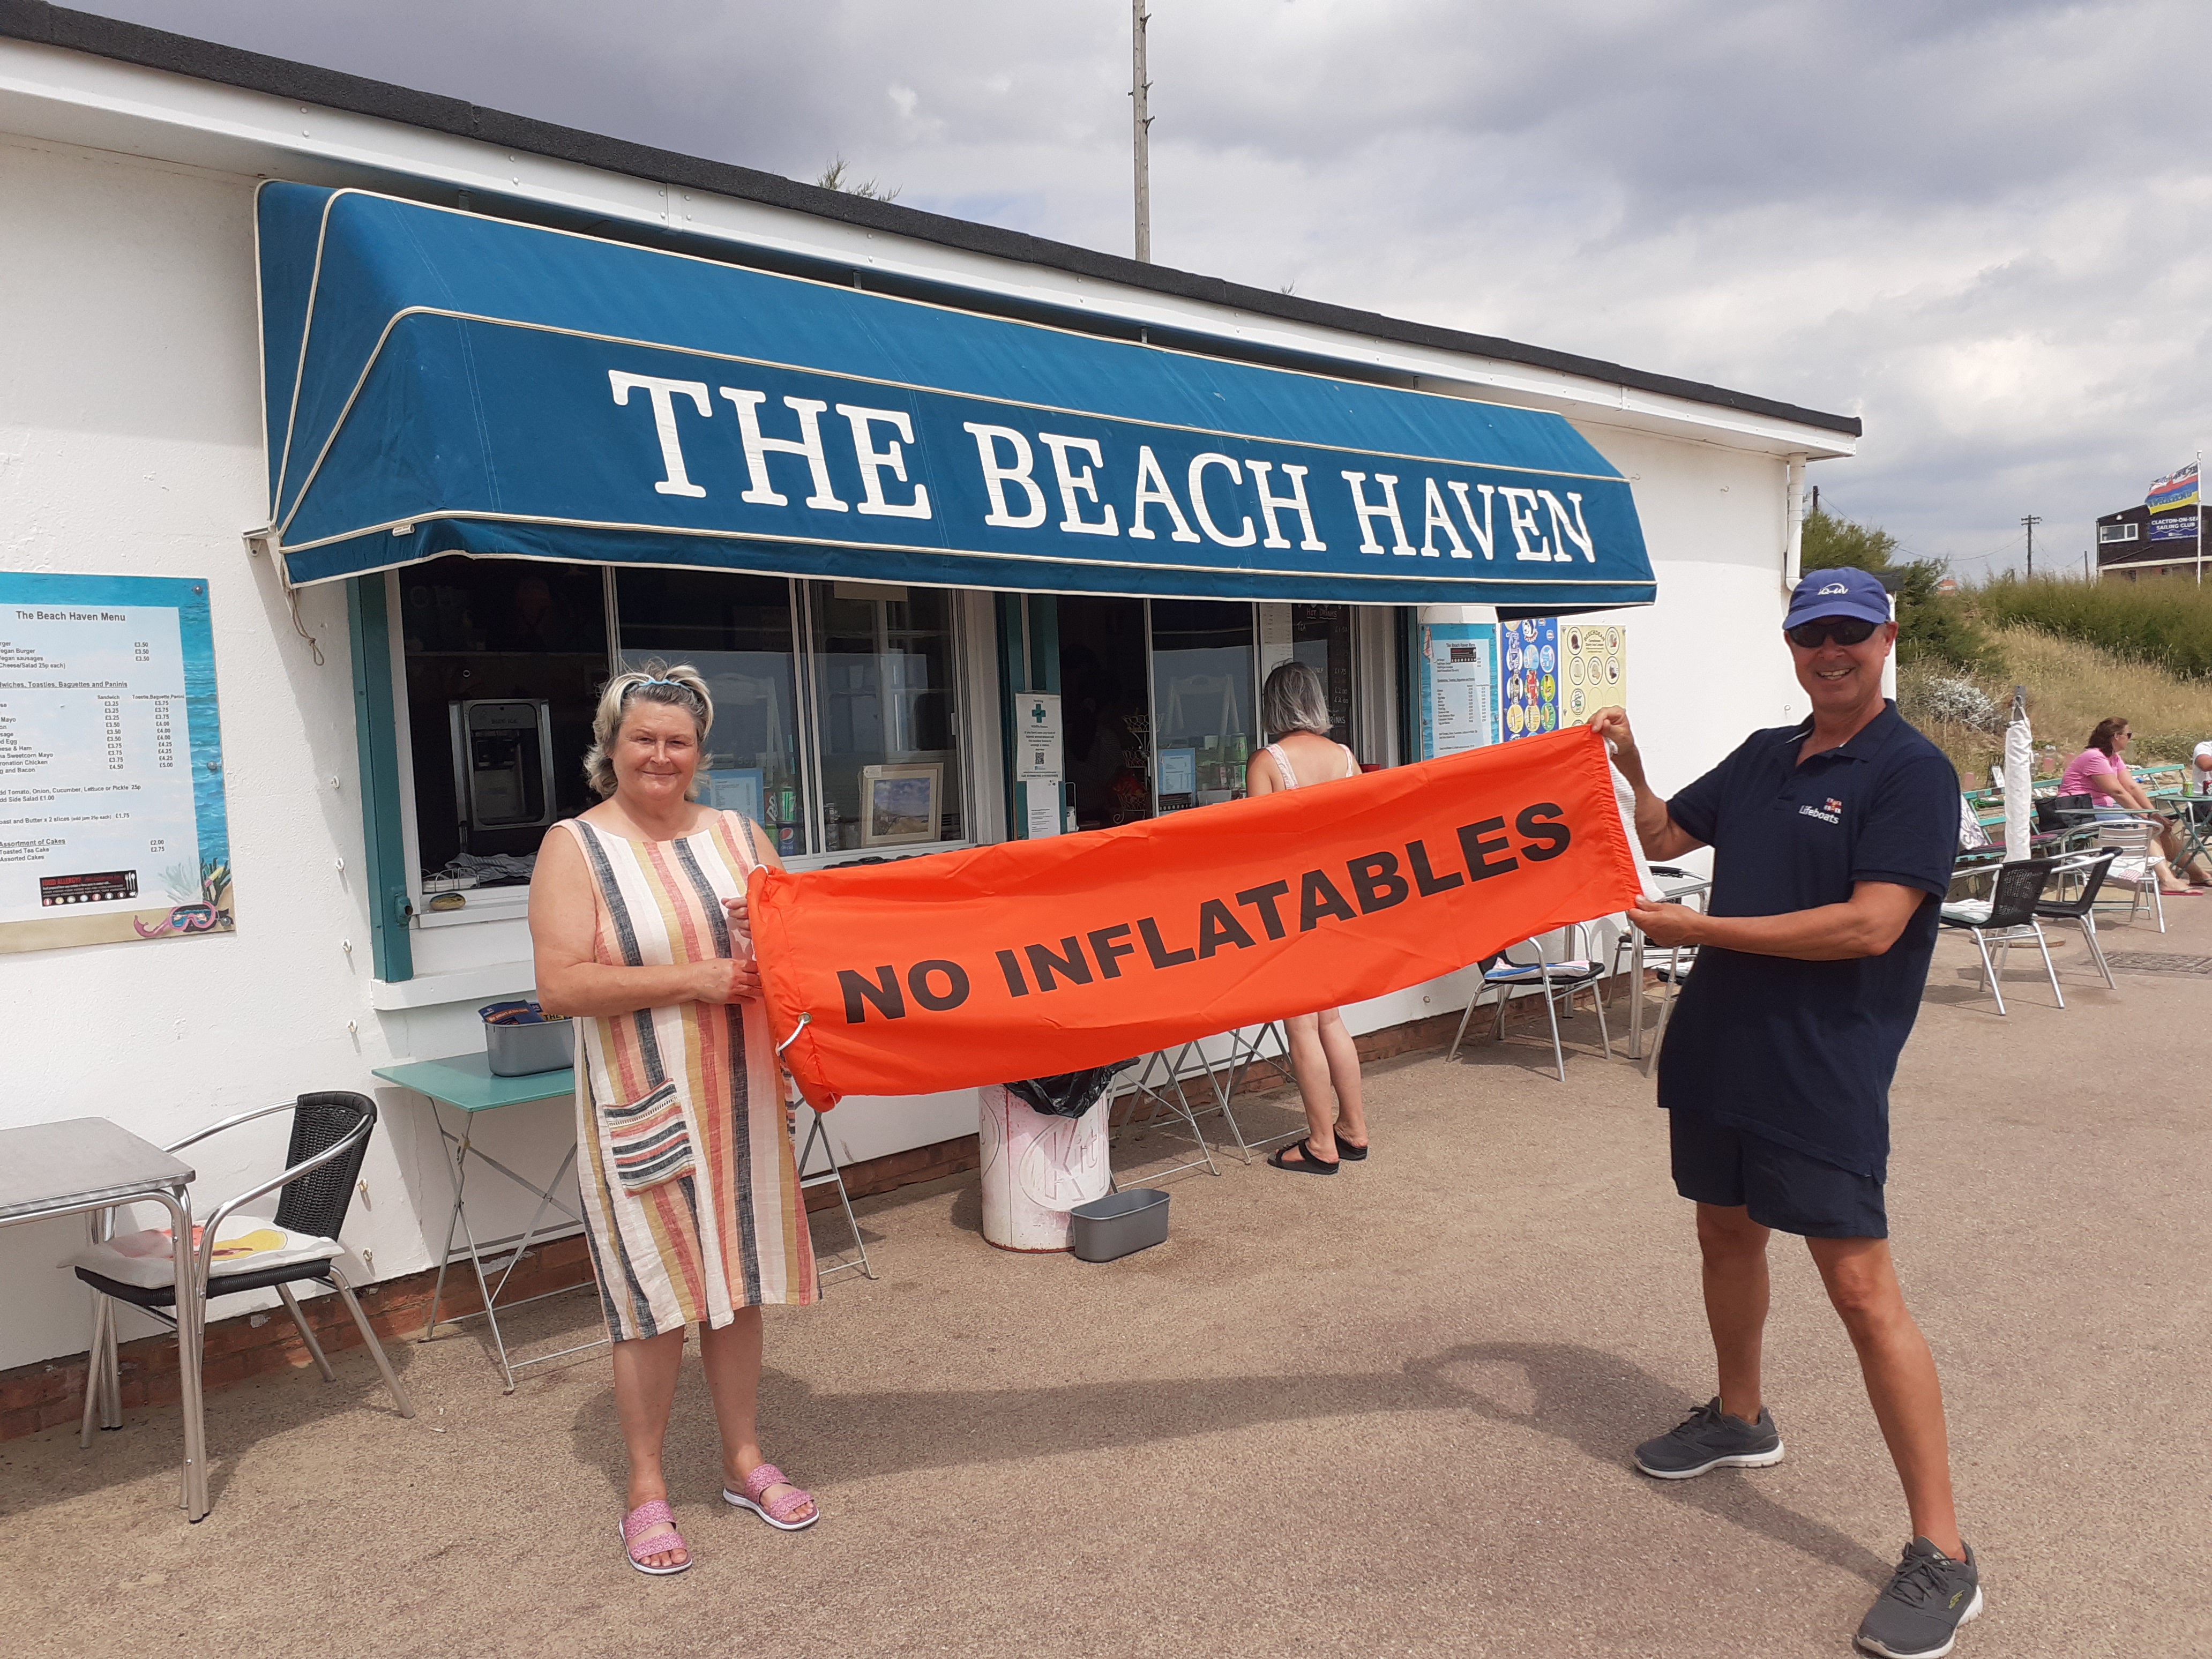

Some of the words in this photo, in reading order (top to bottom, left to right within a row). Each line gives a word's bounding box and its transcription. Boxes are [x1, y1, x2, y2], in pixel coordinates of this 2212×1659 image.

[608, 369, 931, 520] THE
[964, 422, 1326, 551] BEACH
[1341, 470, 1595, 563] HAVEN
[16, 611, 34, 619] The
[37, 611, 66, 621] Beach
[70, 612, 98, 621] Haven
[101, 612, 126, 622] Menu
[1798, 805, 1840, 825] Lifeboats
[836, 959, 970, 1024] NO
[994, 802, 1572, 999] INFLATABLES
